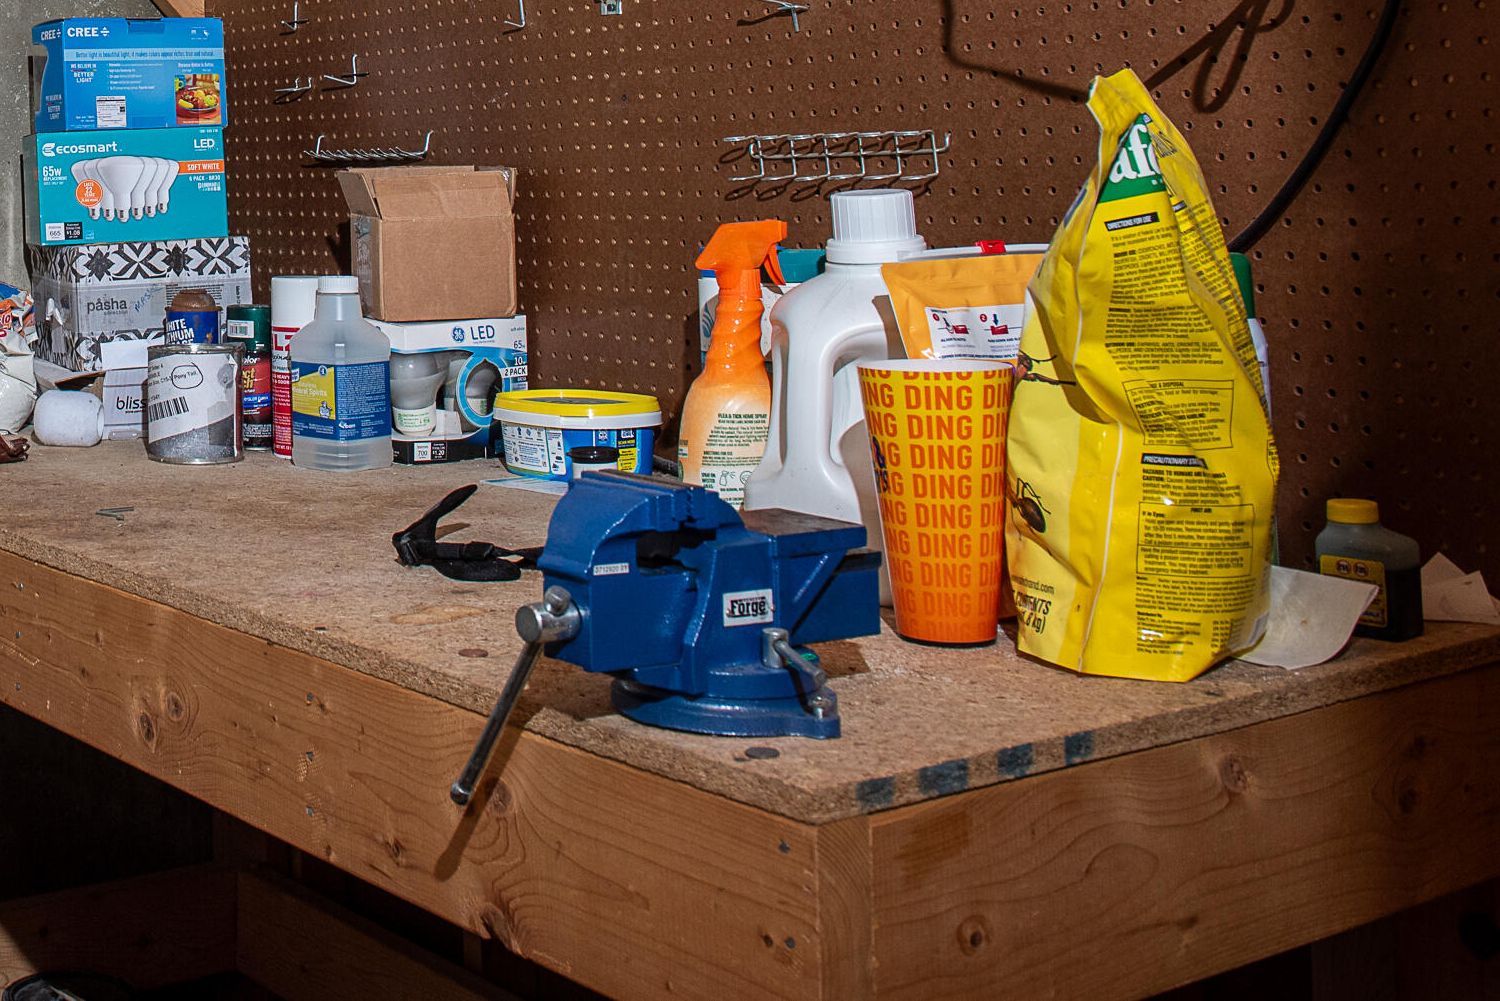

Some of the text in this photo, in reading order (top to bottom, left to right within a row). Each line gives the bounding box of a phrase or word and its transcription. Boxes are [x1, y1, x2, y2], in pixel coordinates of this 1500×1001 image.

[40, 29, 56, 41] CREE
[67, 26, 99, 38] CREE
[88, 51, 98, 59] light
[56, 141, 118, 154] ecosmart
[193, 138, 215, 149] LED
[187, 162, 220, 171] SOFT WHITE
[1107, 215, 1152, 230] DIRECTIONS FOR USE
[167, 318, 187, 331] HITE
[470, 325, 495, 340] LED
[510, 367, 526, 376] PACK
[116, 396, 146, 410] bliss
[904, 385, 973, 411] DING
[907, 414, 973, 440] DING
[909, 444, 973, 470] DING
[1143, 455, 1188, 465] PRECAUTIONARY
[912, 474, 972, 499] DING
[915, 503, 972, 529] DING
[918, 532, 972, 559] DING
[920, 562, 972, 588] DING
[730, 599, 766, 617] Forge
[923, 591, 972, 617] DING
